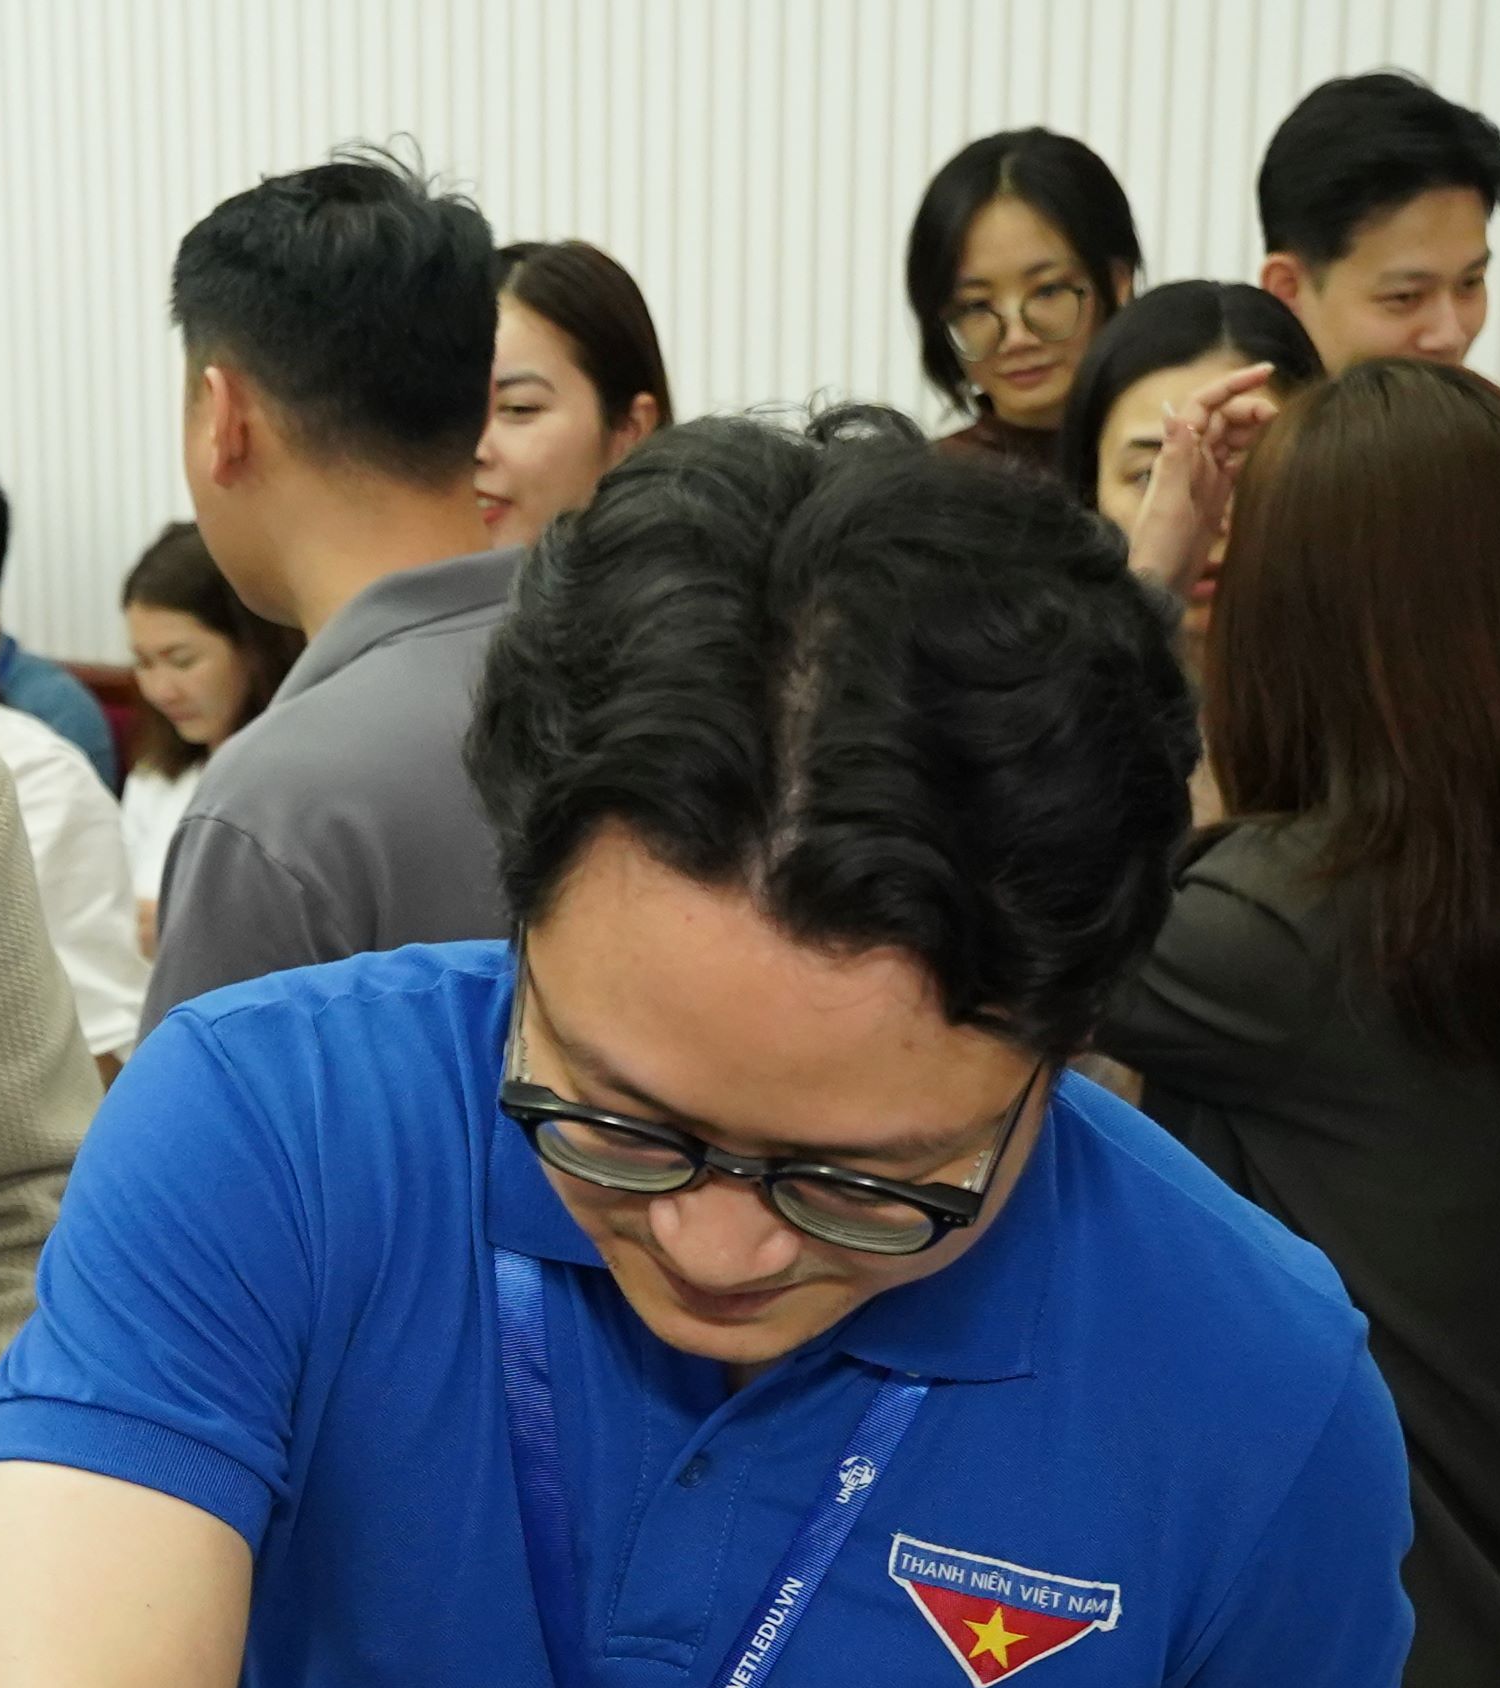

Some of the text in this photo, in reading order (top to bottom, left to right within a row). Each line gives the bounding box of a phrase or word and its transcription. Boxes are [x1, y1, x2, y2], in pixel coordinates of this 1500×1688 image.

[901, 1552, 1108, 1615] THANH NIÊN VIỆT NAM
